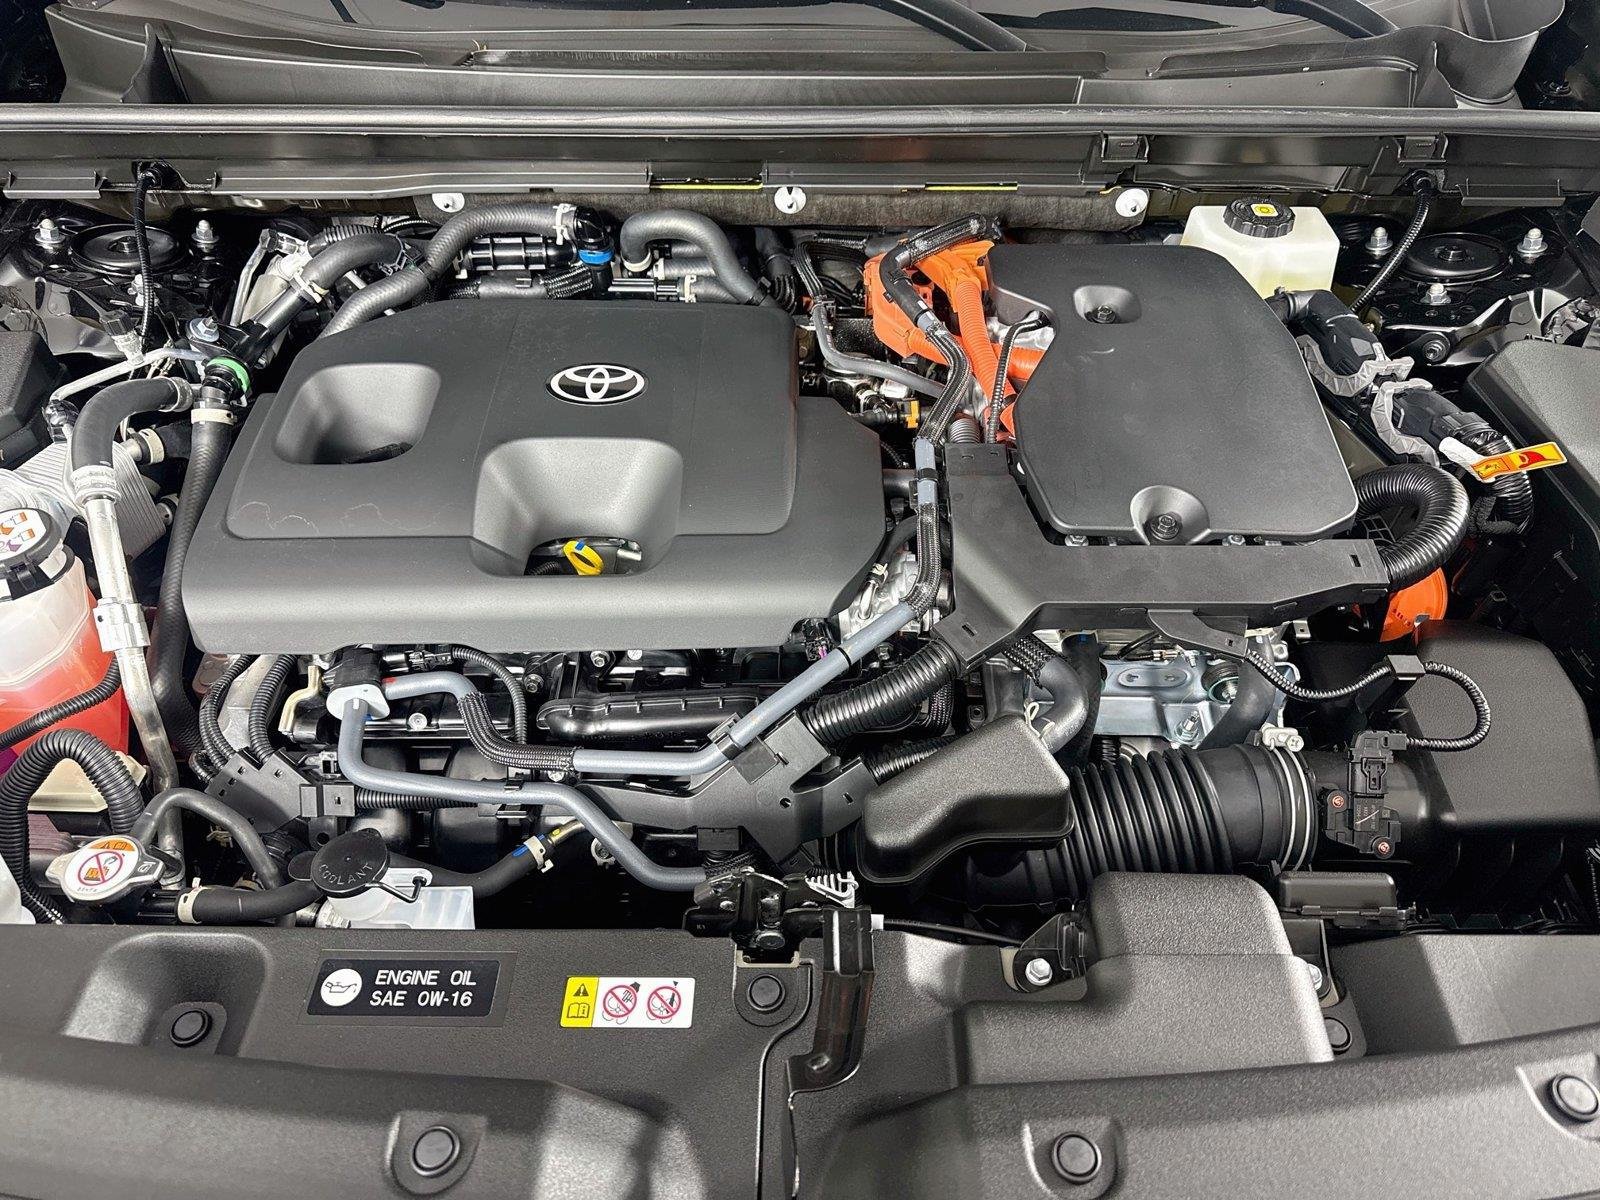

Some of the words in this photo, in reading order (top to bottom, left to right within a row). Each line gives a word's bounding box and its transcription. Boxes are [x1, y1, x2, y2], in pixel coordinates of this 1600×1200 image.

[319, 863, 373, 885] COOLANT
[374, 969, 440, 986] ENGINE
[450, 969, 477, 986] OIL
[369, 990, 407, 1007] SAE
[417, 990, 473, 1007] 0W-16
